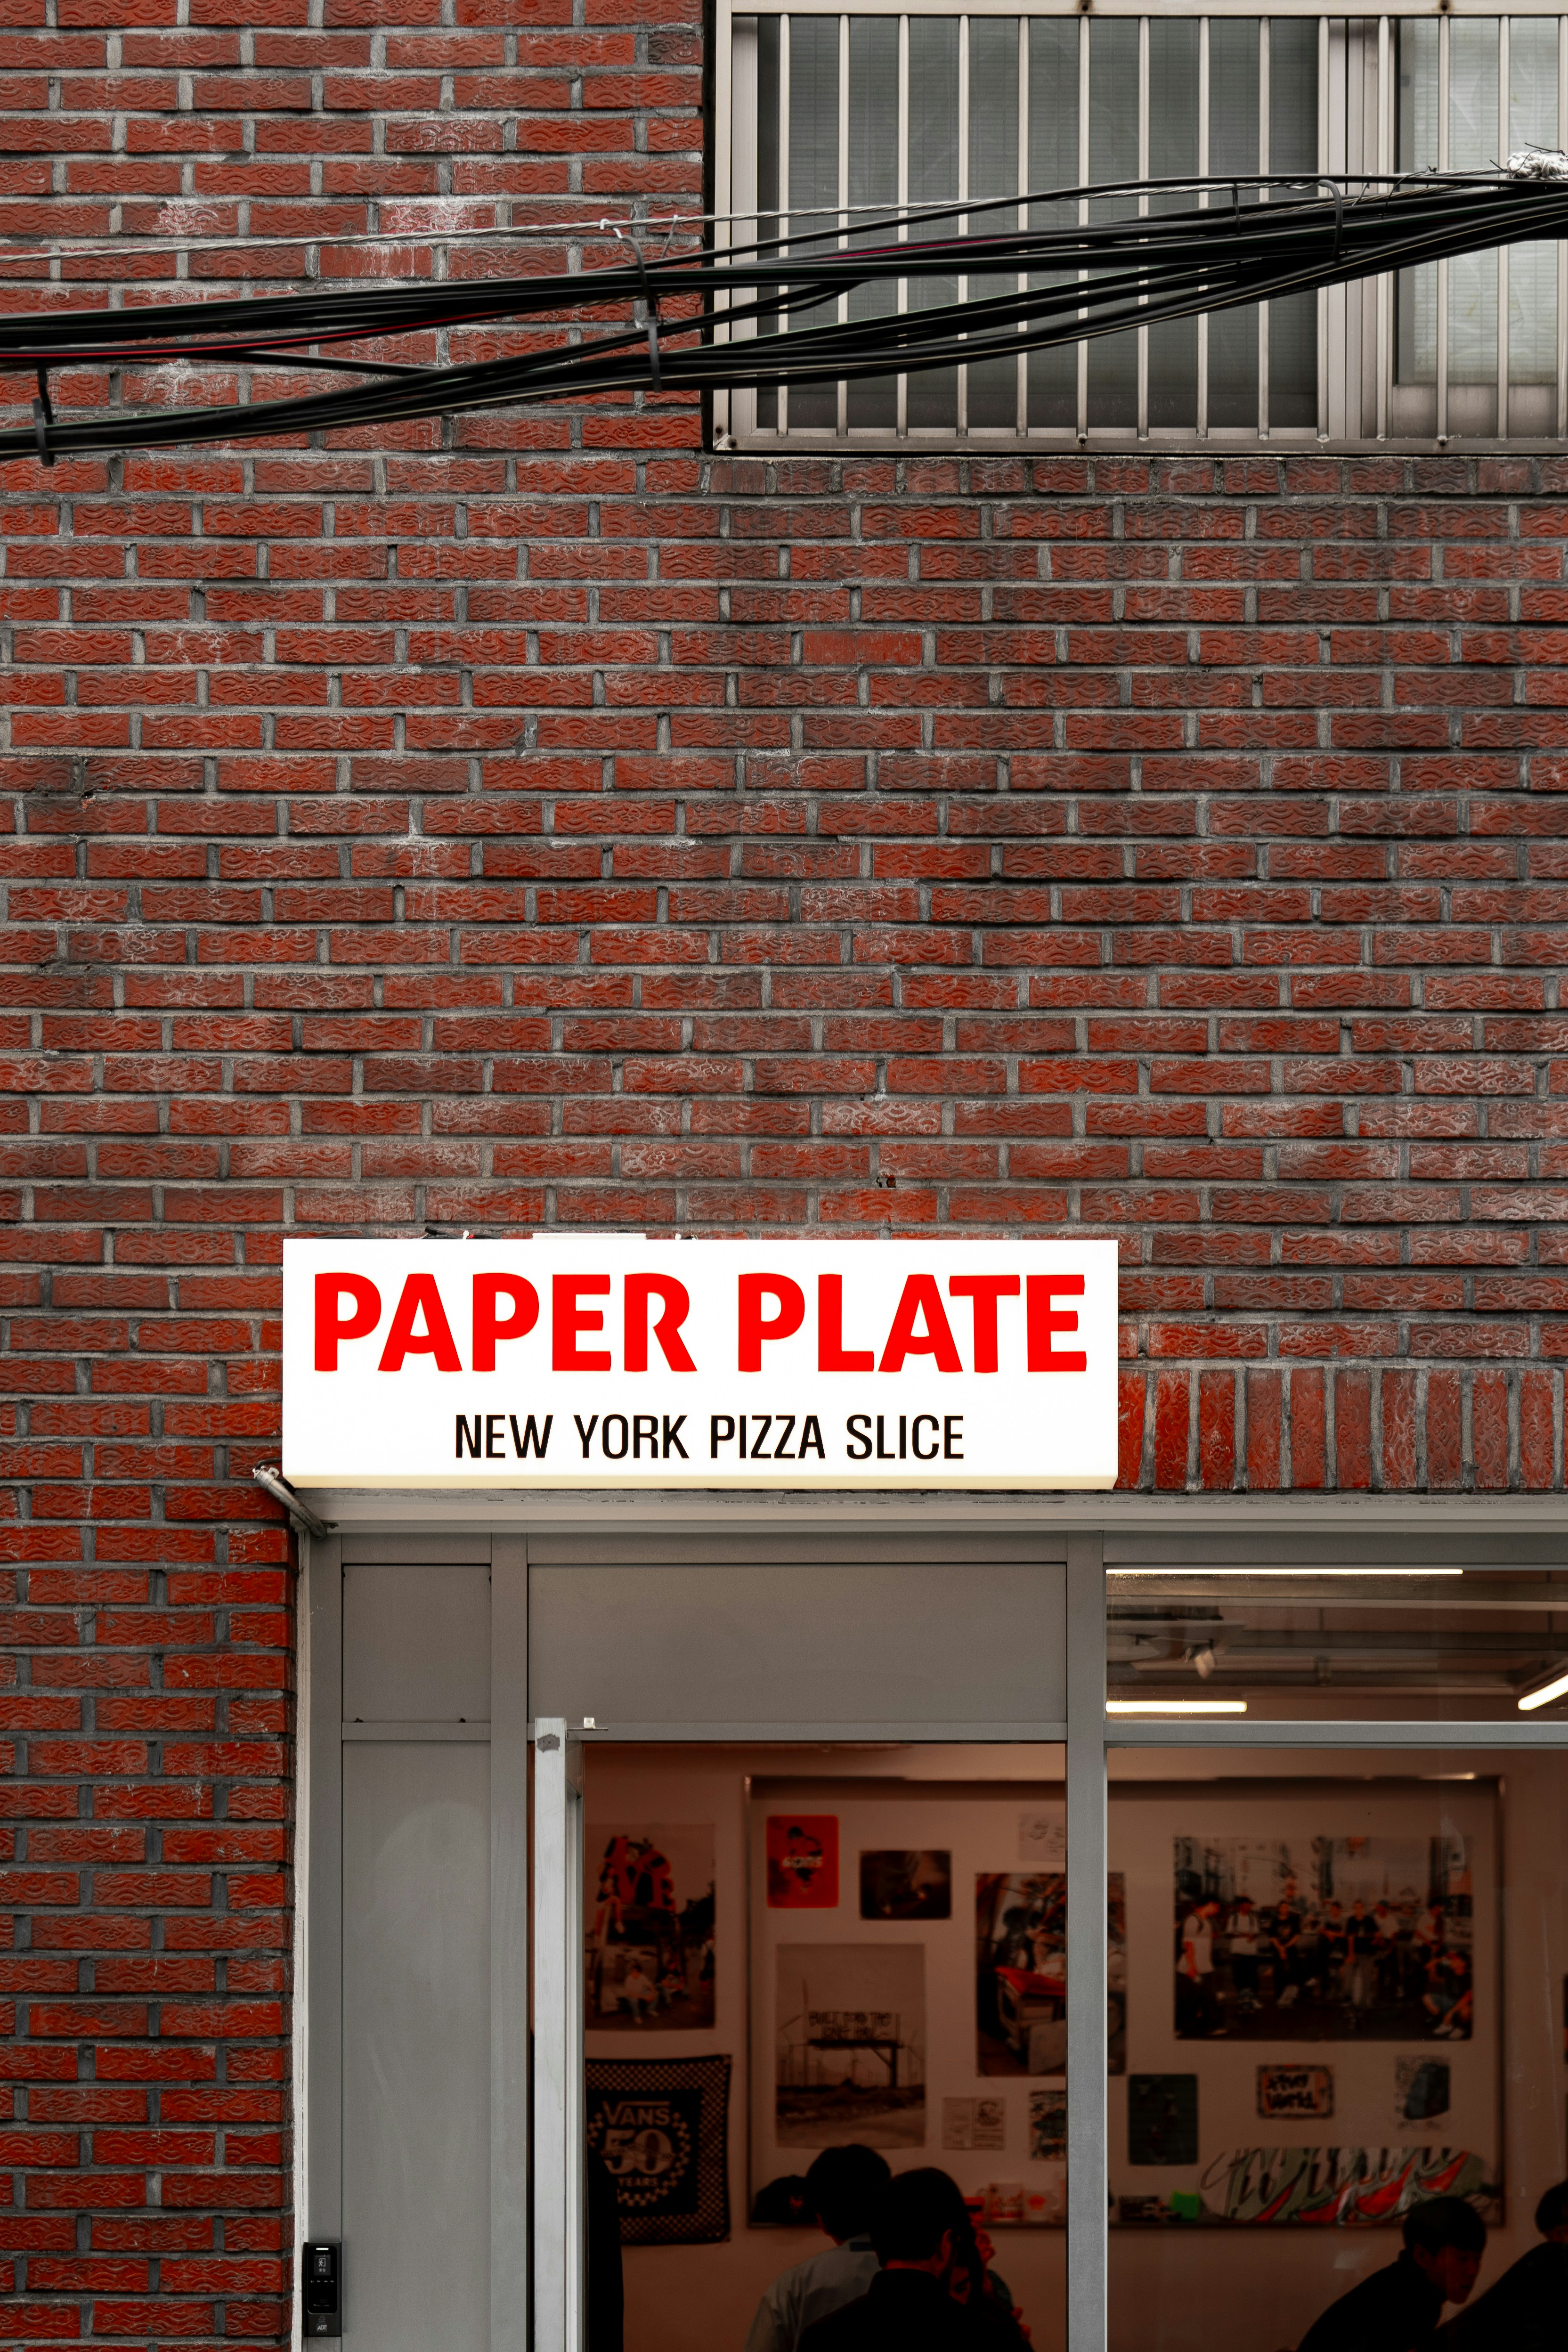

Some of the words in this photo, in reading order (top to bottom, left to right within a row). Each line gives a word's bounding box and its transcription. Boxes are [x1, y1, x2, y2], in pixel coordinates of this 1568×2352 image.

[315, 1272, 698, 1373] PAPER
[738, 1273, 1087, 1373] PLATE
[456, 1415, 553, 1459] NEW
[573, 1414, 690, 1459] YORK
[711, 1415, 826, 1459] PIZZA
[846, 1414, 964, 1460] SLICE
[601, 2100, 671, 2126] VANS
[601, 2127, 674, 2175] 50
[617, 2176, 659, 2188] YEARS
